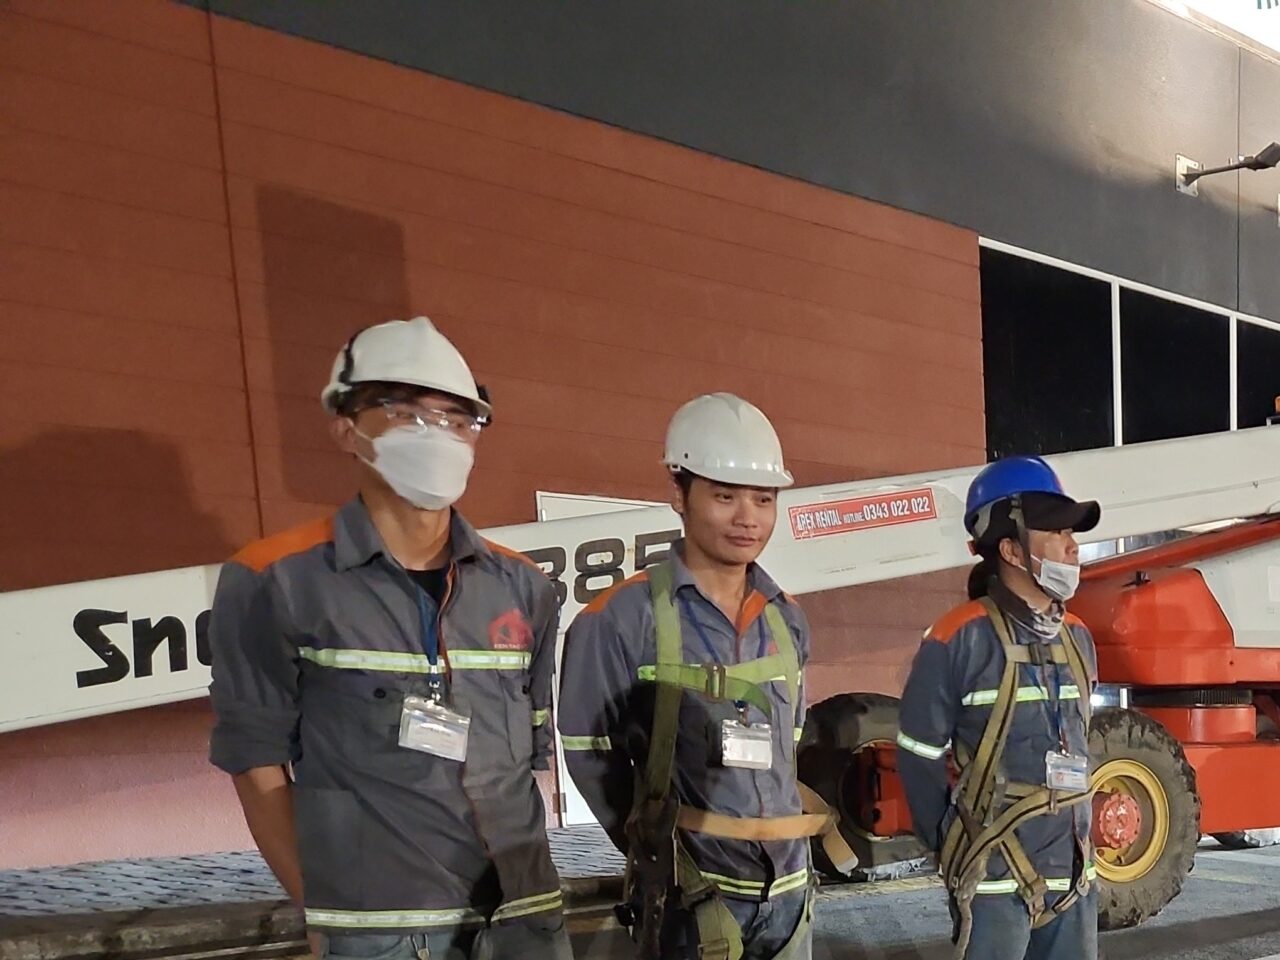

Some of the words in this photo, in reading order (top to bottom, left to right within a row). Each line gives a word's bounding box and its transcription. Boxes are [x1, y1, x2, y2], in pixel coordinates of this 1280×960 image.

[863, 502, 888, 522] 0343
[891, 499, 910, 517] 022
[912, 496, 931, 514] 022
